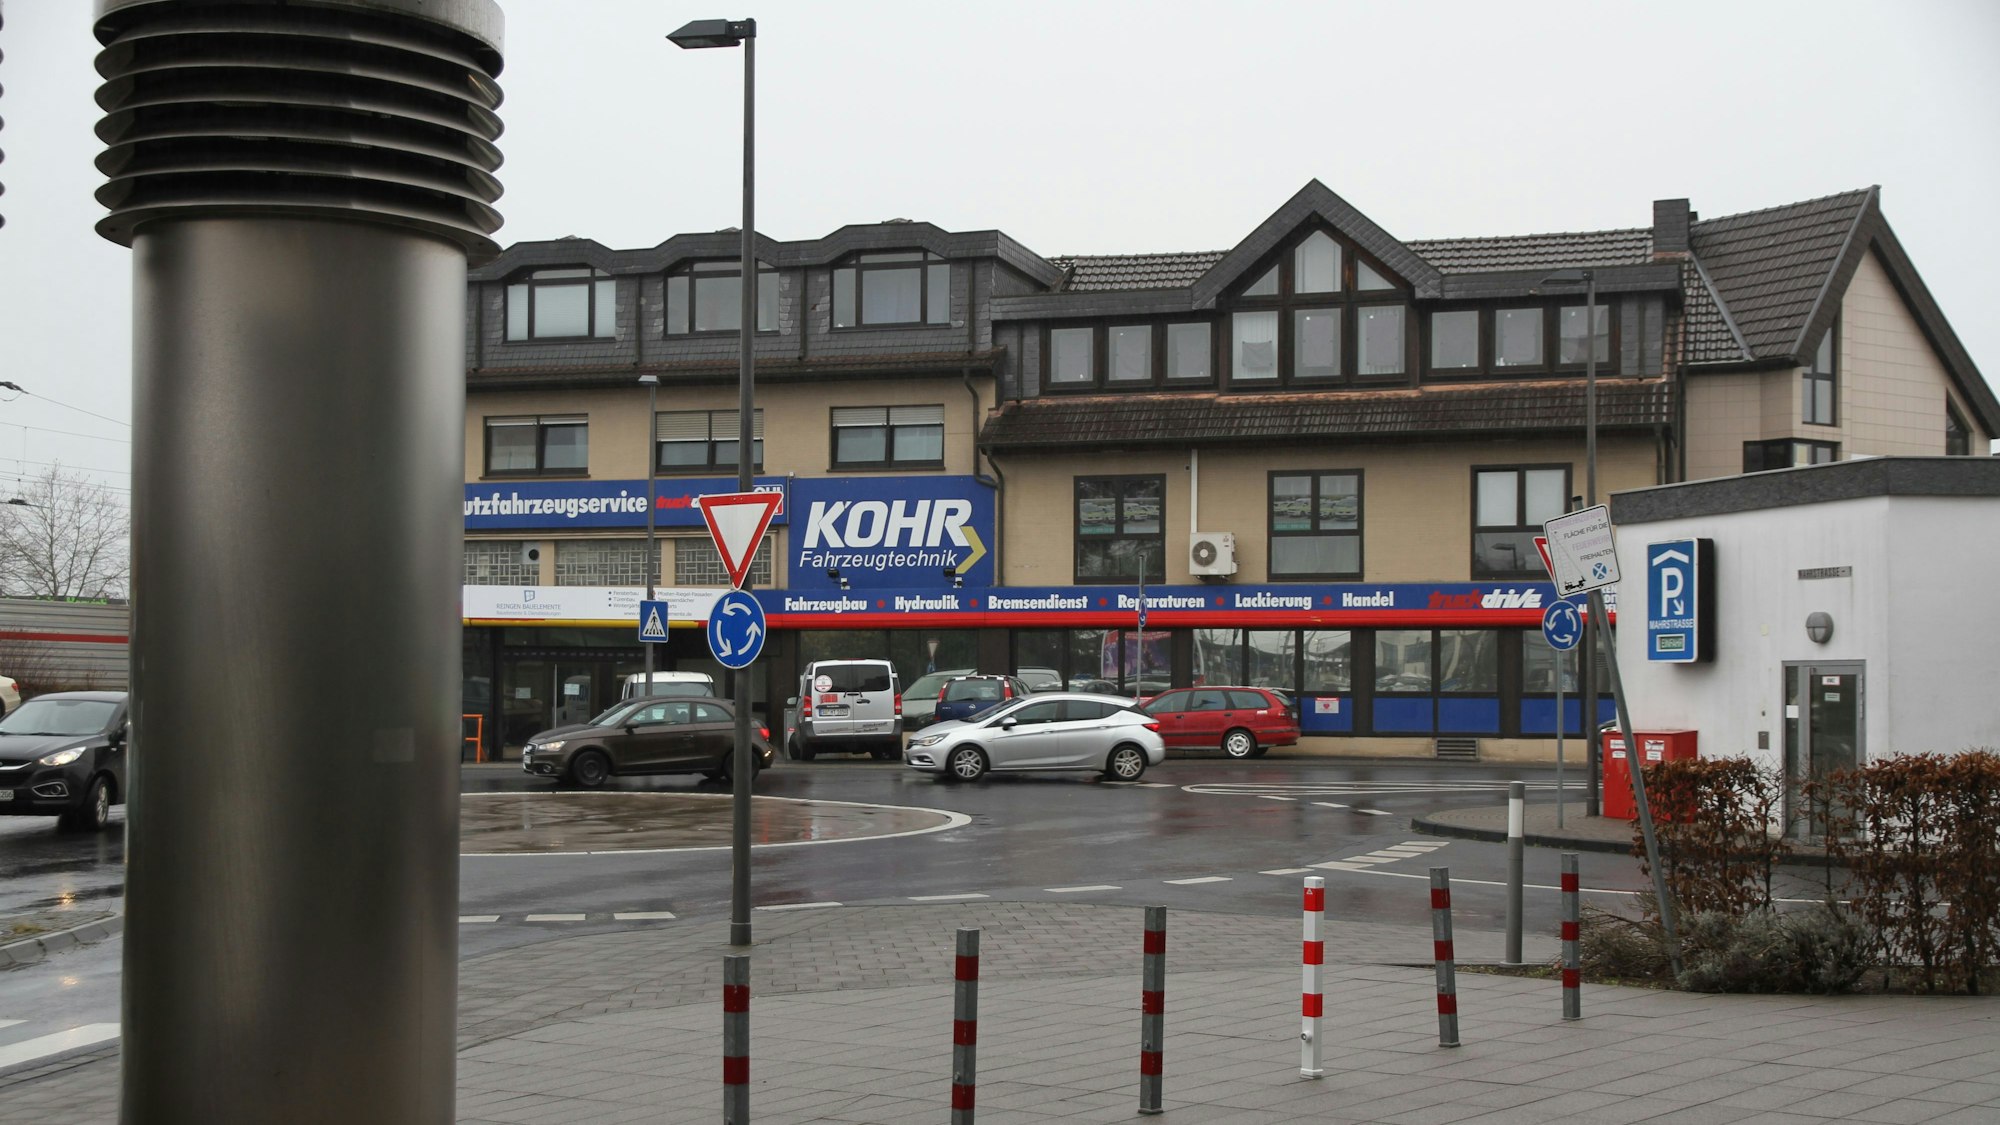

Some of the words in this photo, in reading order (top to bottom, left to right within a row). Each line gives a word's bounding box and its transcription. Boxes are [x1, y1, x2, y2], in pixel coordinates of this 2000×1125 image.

[464, 490, 647, 518] utzfahrzeugservice
[803, 499, 972, 548] KOHR
[1563, 528, 1586, 539] FLÄCHE
[1586, 523, 1598, 534] FÜR
[1598, 521, 1608, 530] DIE
[799, 549, 958, 571] Fahrzeugtechnik
[1580, 548, 1614, 561] FREIHALTEN
[785, 596, 868, 613] Fahrzeugbau
[895, 594, 960, 612] Hydraulik
[988, 594, 1088, 610] Bremsendienst
[1235, 592, 1312, 611] Lackierung
[1342, 591, 1394, 607] Handel
[1649, 618, 1694, 630] MAHRSTRASSE
